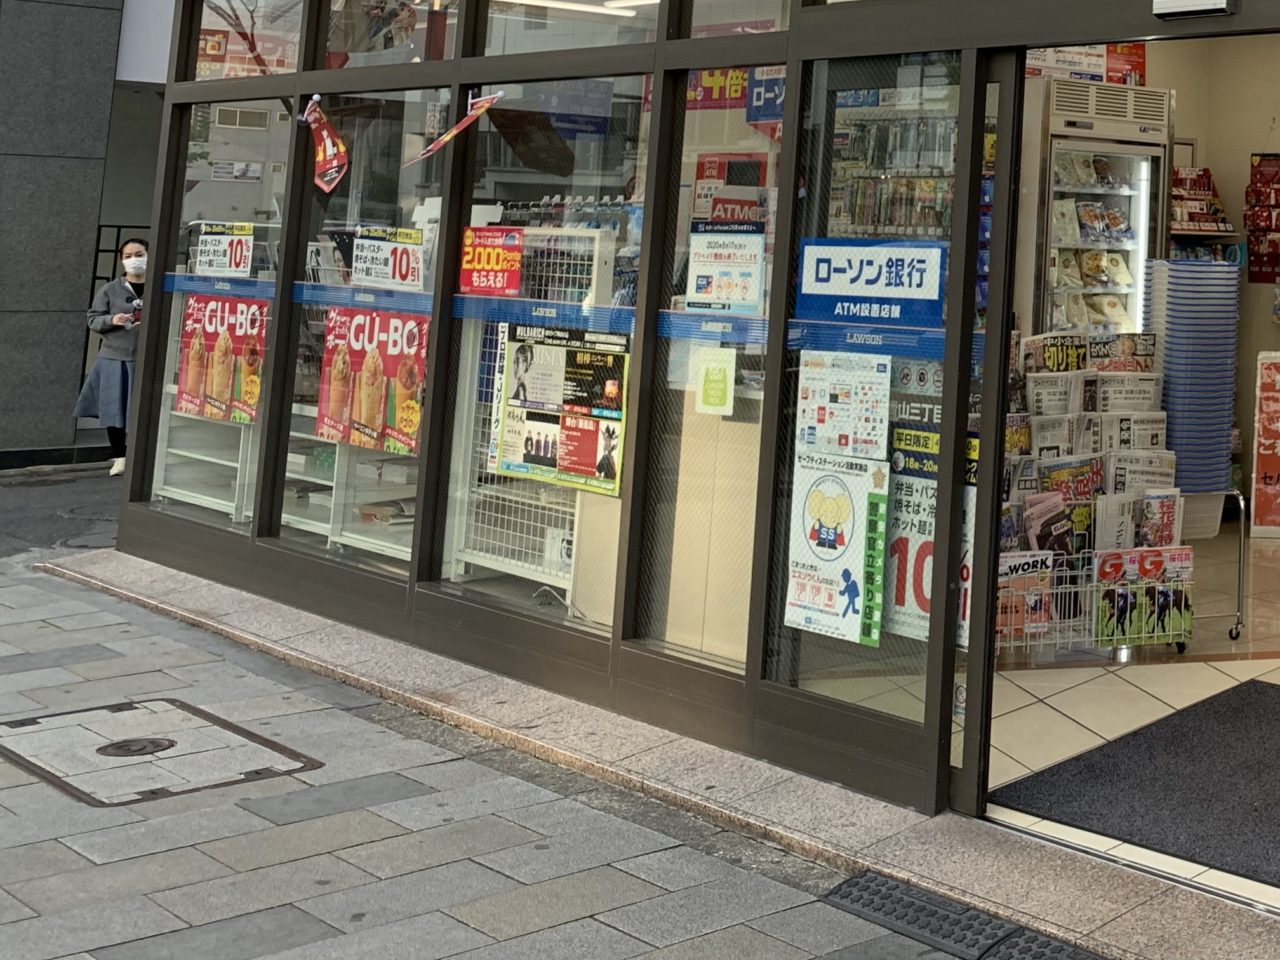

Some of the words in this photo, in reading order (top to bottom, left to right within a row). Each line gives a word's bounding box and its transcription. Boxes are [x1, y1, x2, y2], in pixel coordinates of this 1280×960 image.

[814, 256, 926, 289] ローソン銀行
[834, 301, 900, 318] ATM設置店舗
[846, 333, 883, 345] LAWSON
[820, 527, 835, 540] SS
[1008, 556, 1051, 576] WORK
